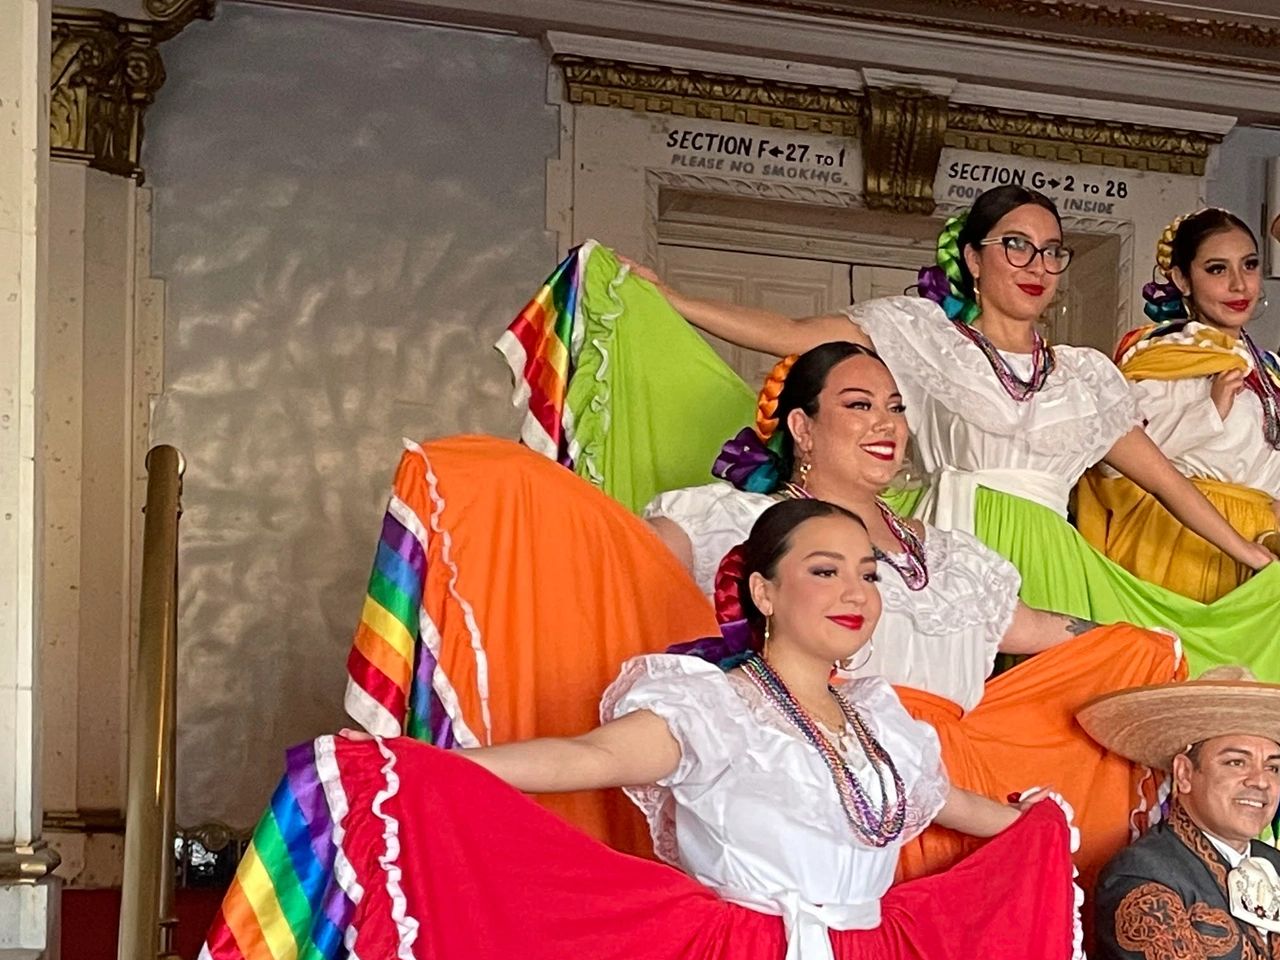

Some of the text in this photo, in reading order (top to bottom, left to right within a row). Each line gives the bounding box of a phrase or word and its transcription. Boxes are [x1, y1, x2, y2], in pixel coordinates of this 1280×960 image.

[667, 130, 846, 168] SECTION F 27 TO 1
[671, 154, 848, 186] PLEASE NO SMOKING.
[948, 162, 1128, 199] SECTION G 2 TO 28
[1063, 198, 1115, 214] INSIDE
